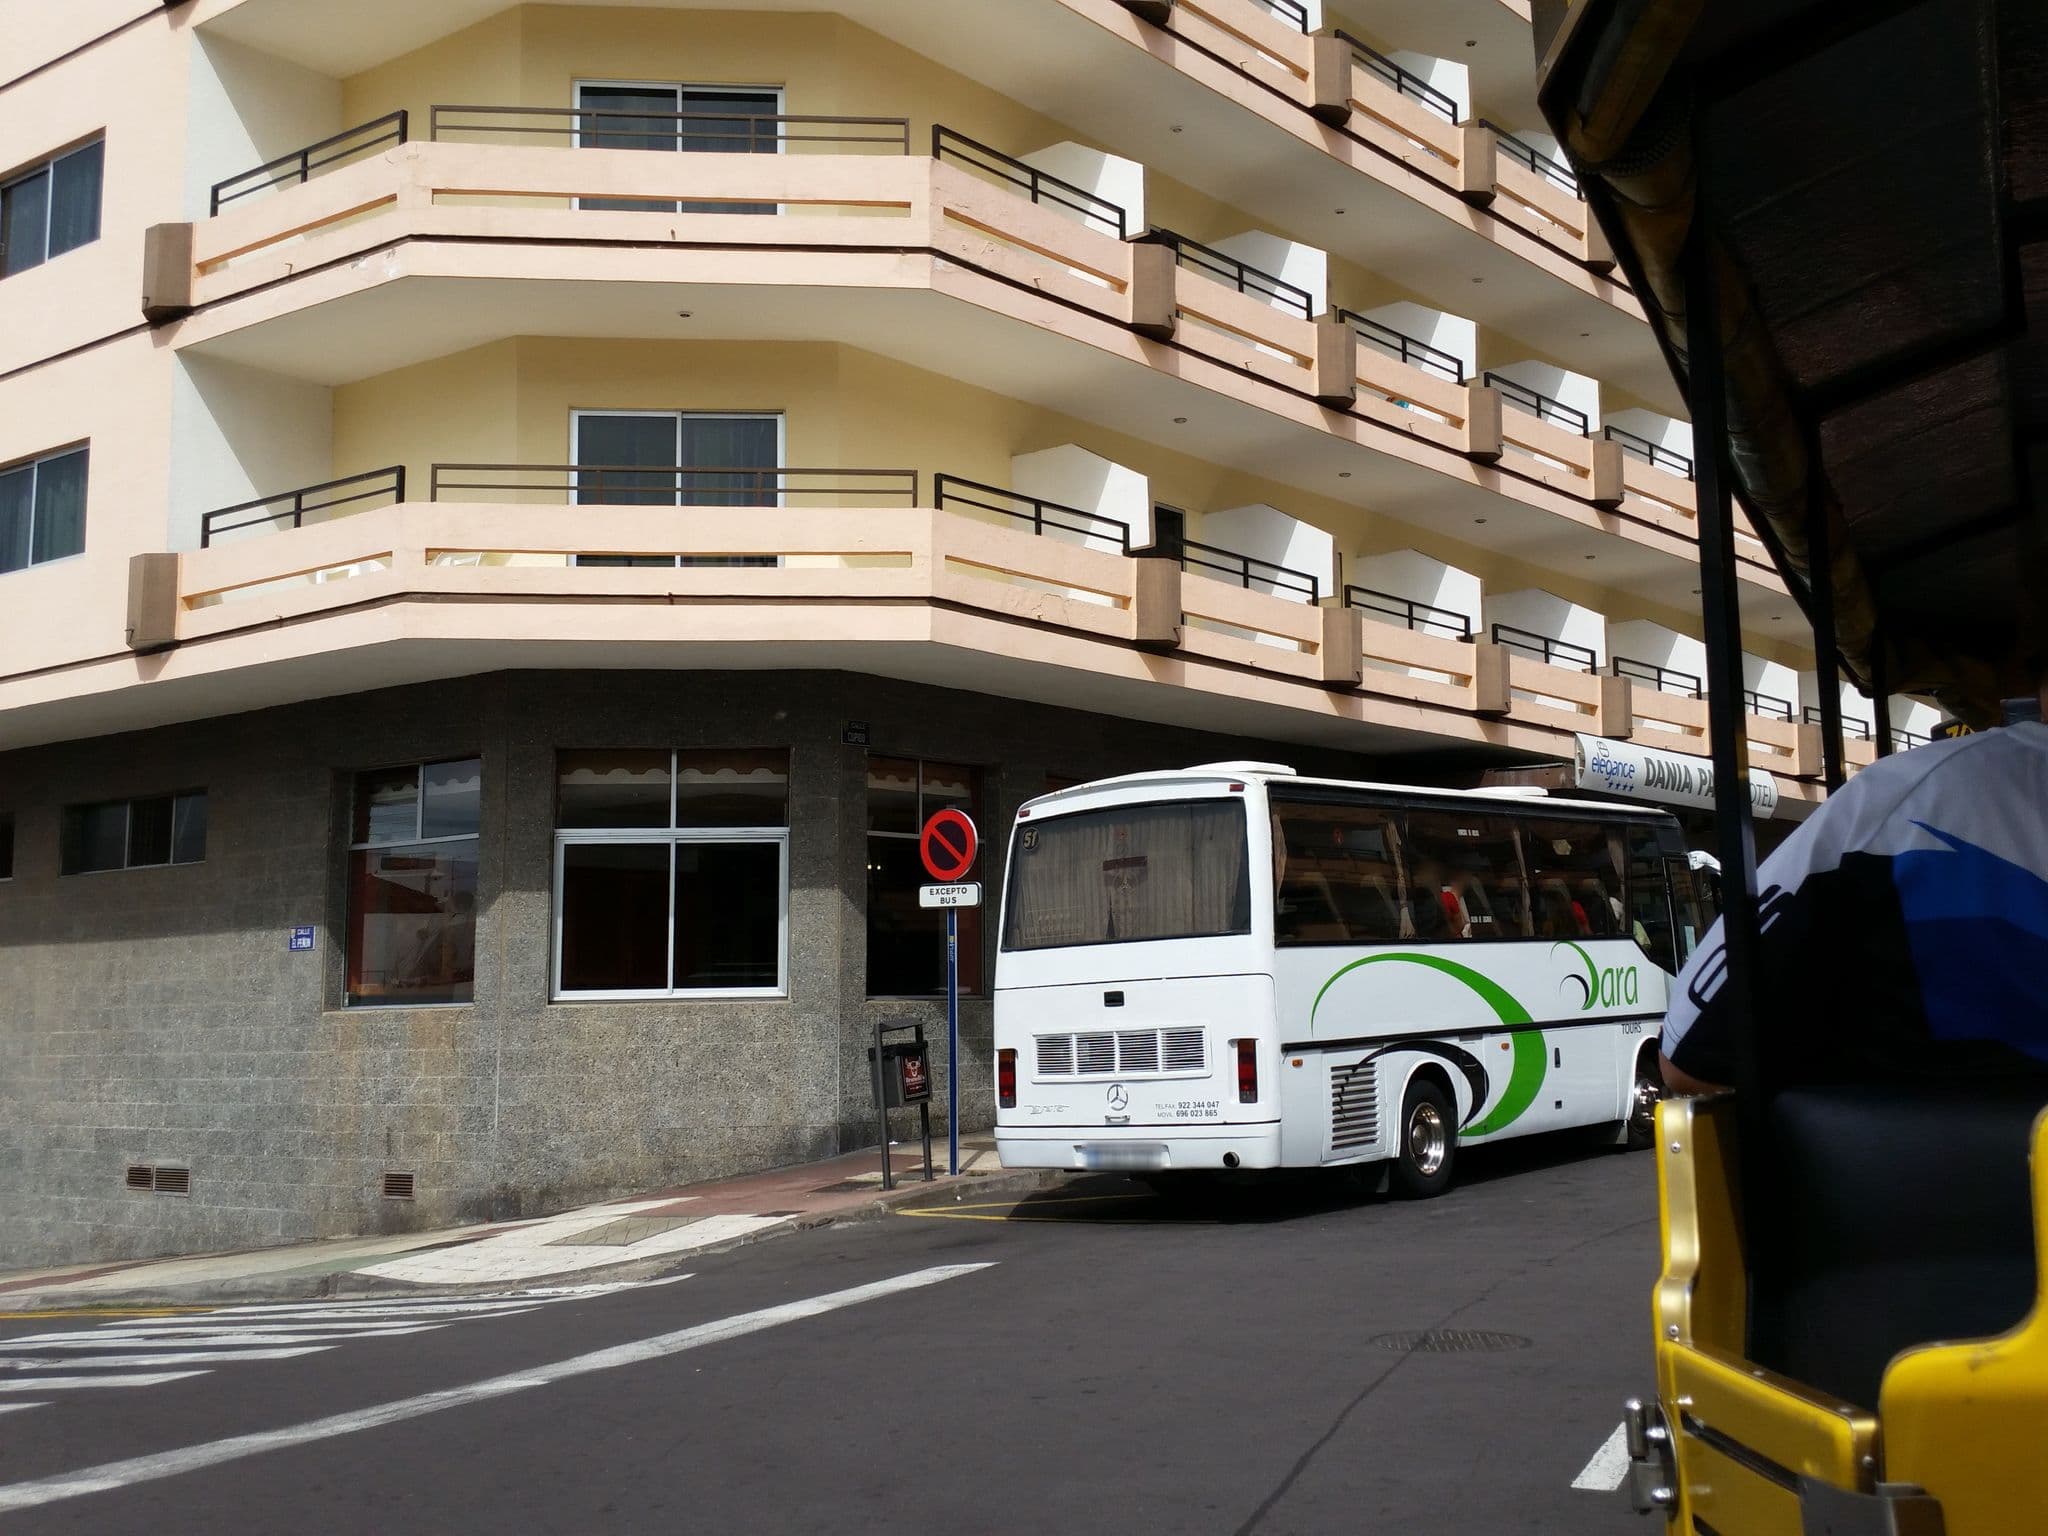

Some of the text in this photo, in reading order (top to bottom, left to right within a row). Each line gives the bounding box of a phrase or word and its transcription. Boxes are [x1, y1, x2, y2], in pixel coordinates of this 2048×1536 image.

[1591, 755, 1635, 781] elegance
[1643, 757, 1773, 808] DANIA PA OTEL
[1023, 831, 1037, 848] 51
[929, 887, 968, 896] EXCEPTO
[940, 896, 957, 904] BUS
[1621, 1023, 1642, 1035] TOURS
[1178, 1101, 1191, 1109] 922
[1192, 1101, 1205, 1109] 344
